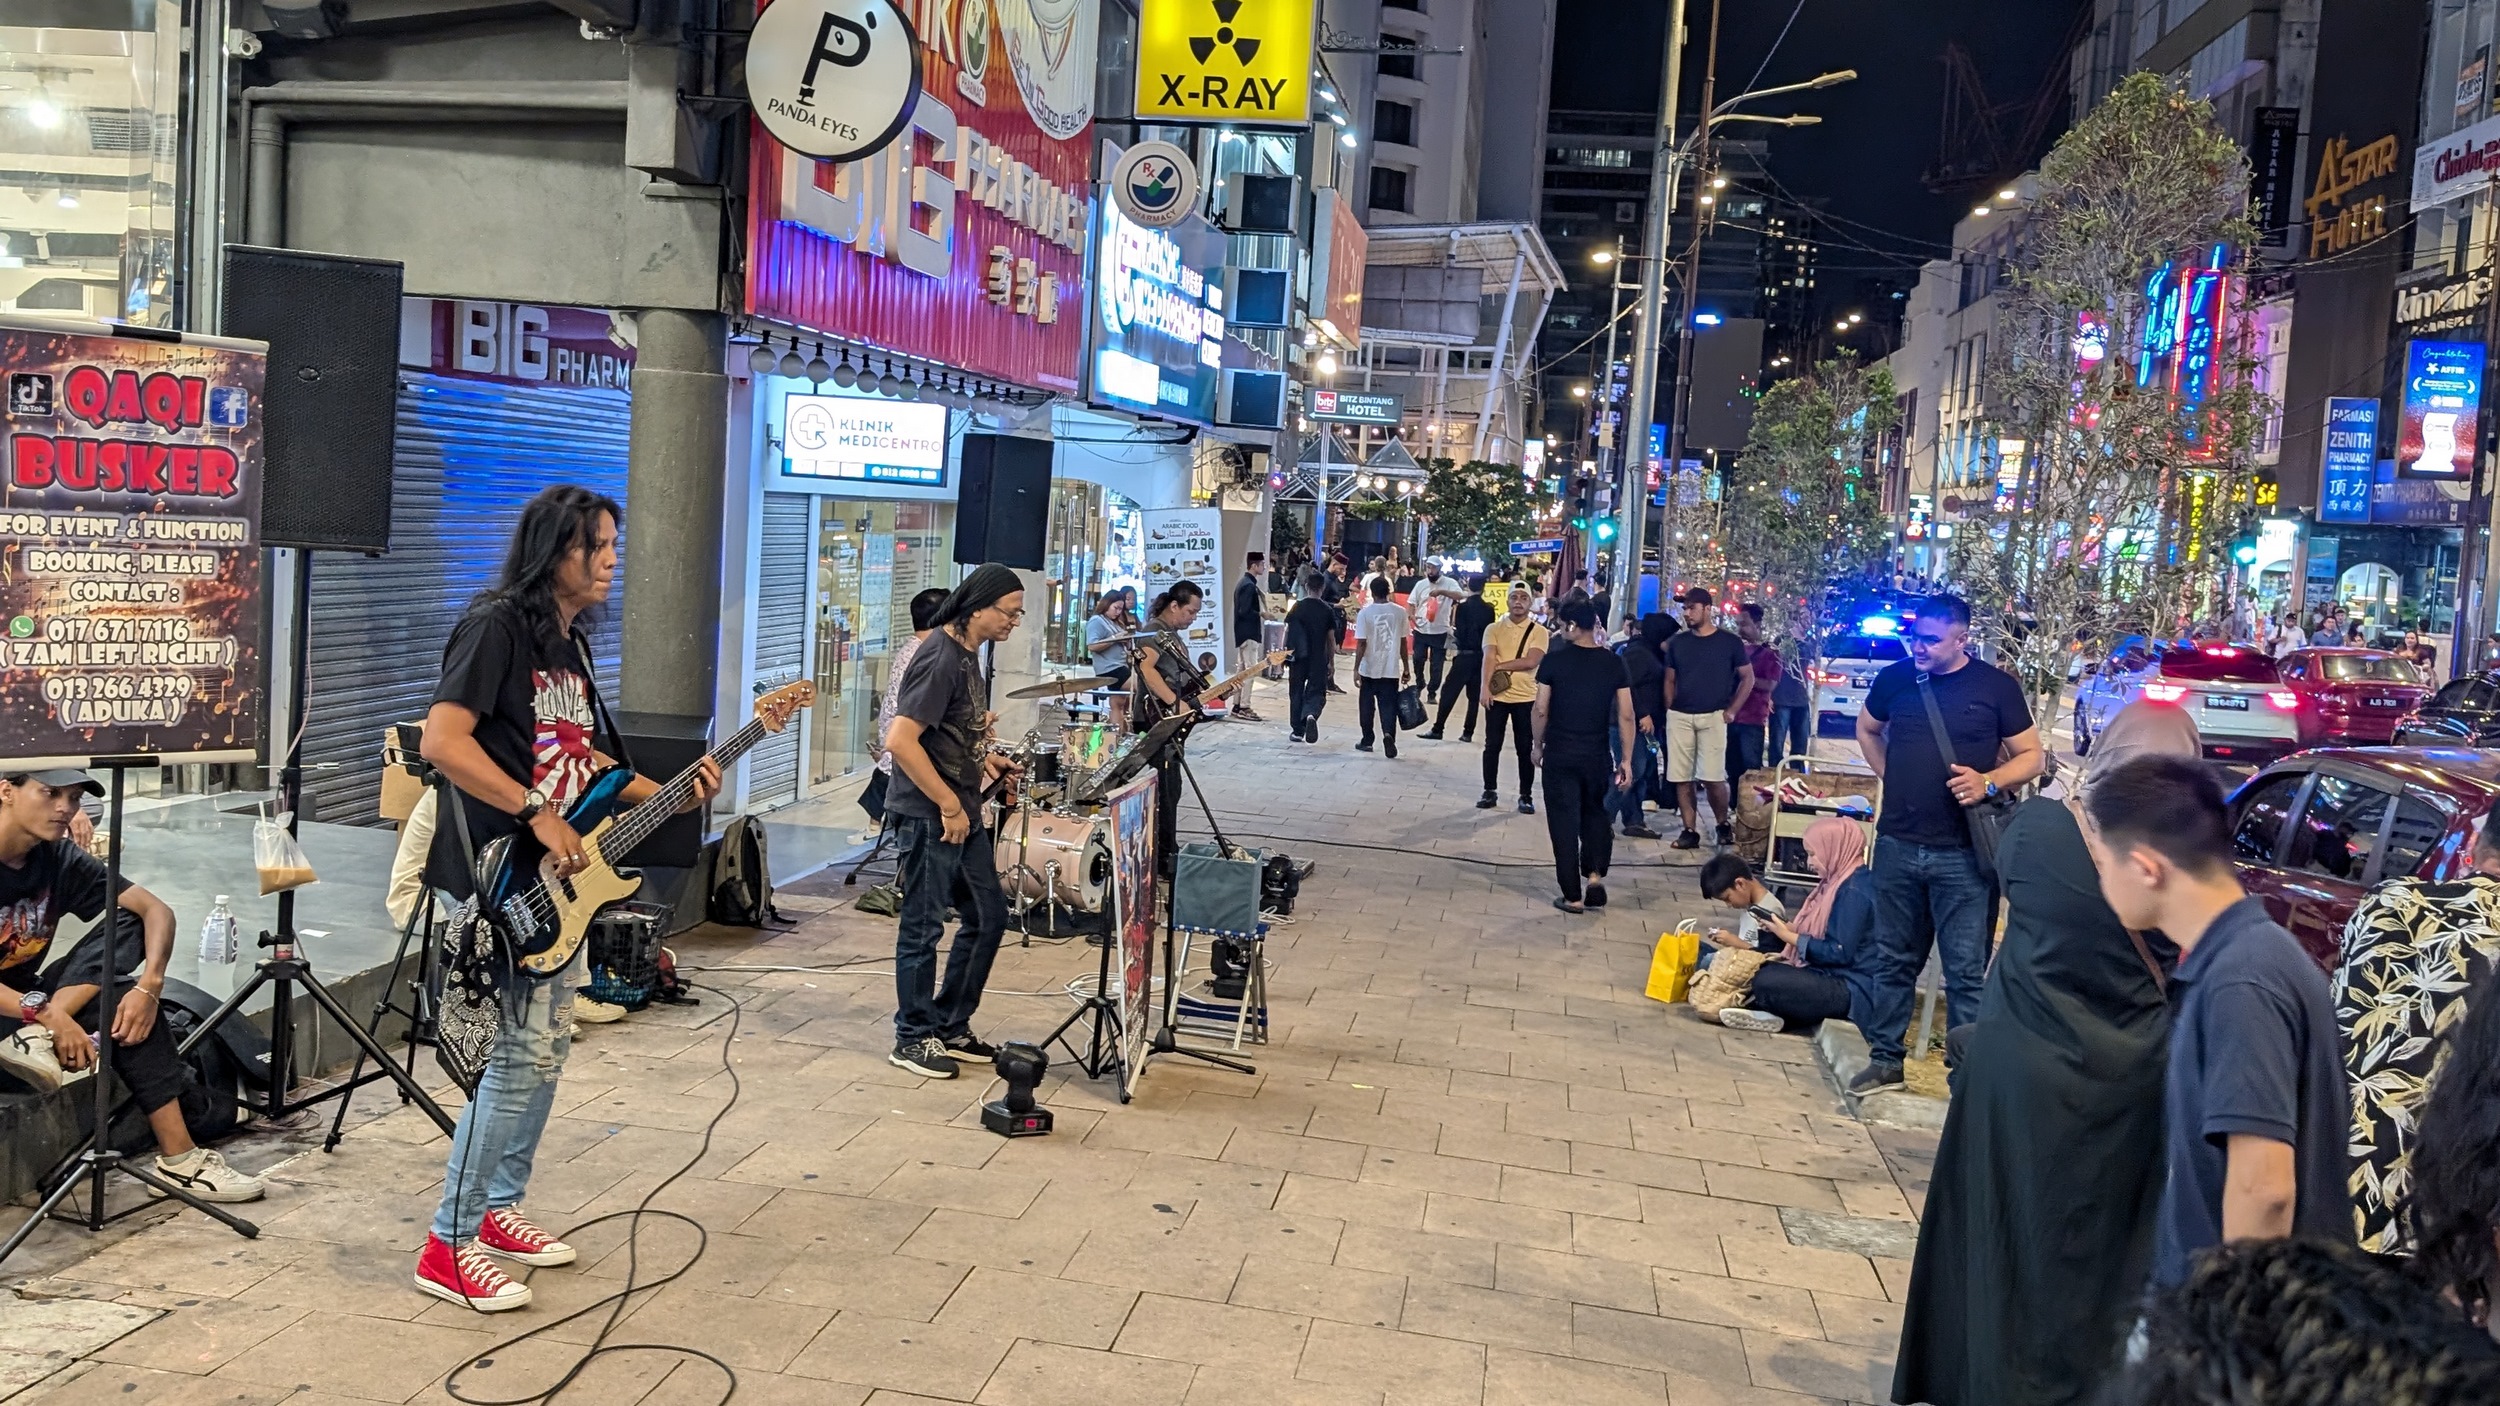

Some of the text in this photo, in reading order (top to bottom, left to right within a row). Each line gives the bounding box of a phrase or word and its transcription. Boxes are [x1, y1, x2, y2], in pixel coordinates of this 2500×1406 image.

[1158, 74, 1287, 111] X-RAY
[767, 98, 859, 141] PANDA EYES
[1129, 207, 1177, 222] PHARMACY
[2264, 182, 2277, 229] HOTEL
[2310, 194, 2387, 259] HOTEL
[458, 302, 550, 381] BIG
[17, 405, 46, 413] TikTok
[65, 366, 207, 434] QAQI
[1340, 395, 1357, 403] BITZ
[1359, 397, 1394, 405] BINTANG
[1346, 405, 1385, 417] HOTEL
[840, 418, 894, 433] KLINIK
[2332, 409, 2374, 422] FARMASI
[839, 435, 942, 452] MEDICENTRO
[2330, 432, 2372, 449] ZENITH
[11, 433, 240, 498] BUSKER
[2329, 451, 2371, 464] PHARMACY
[0, 515, 244, 541] FOR EVENT & FUNCTION
[1186, 538, 1215, 551] 12.90
[30, 552, 214, 575] BOOKING, PLEASE
[71, 582, 168, 602] CONTACT
[1484, 590, 1507, 598] LAST
[48, 619, 189, 642] 017 671 7116
[13, 642, 73, 665] ZAM
[77, 642, 138, 665] LEFT
[142, 641, 221, 665] RIGHT
[46, 675, 192, 700] 013 266 4329
[76, 700, 167, 723] ADUKA
